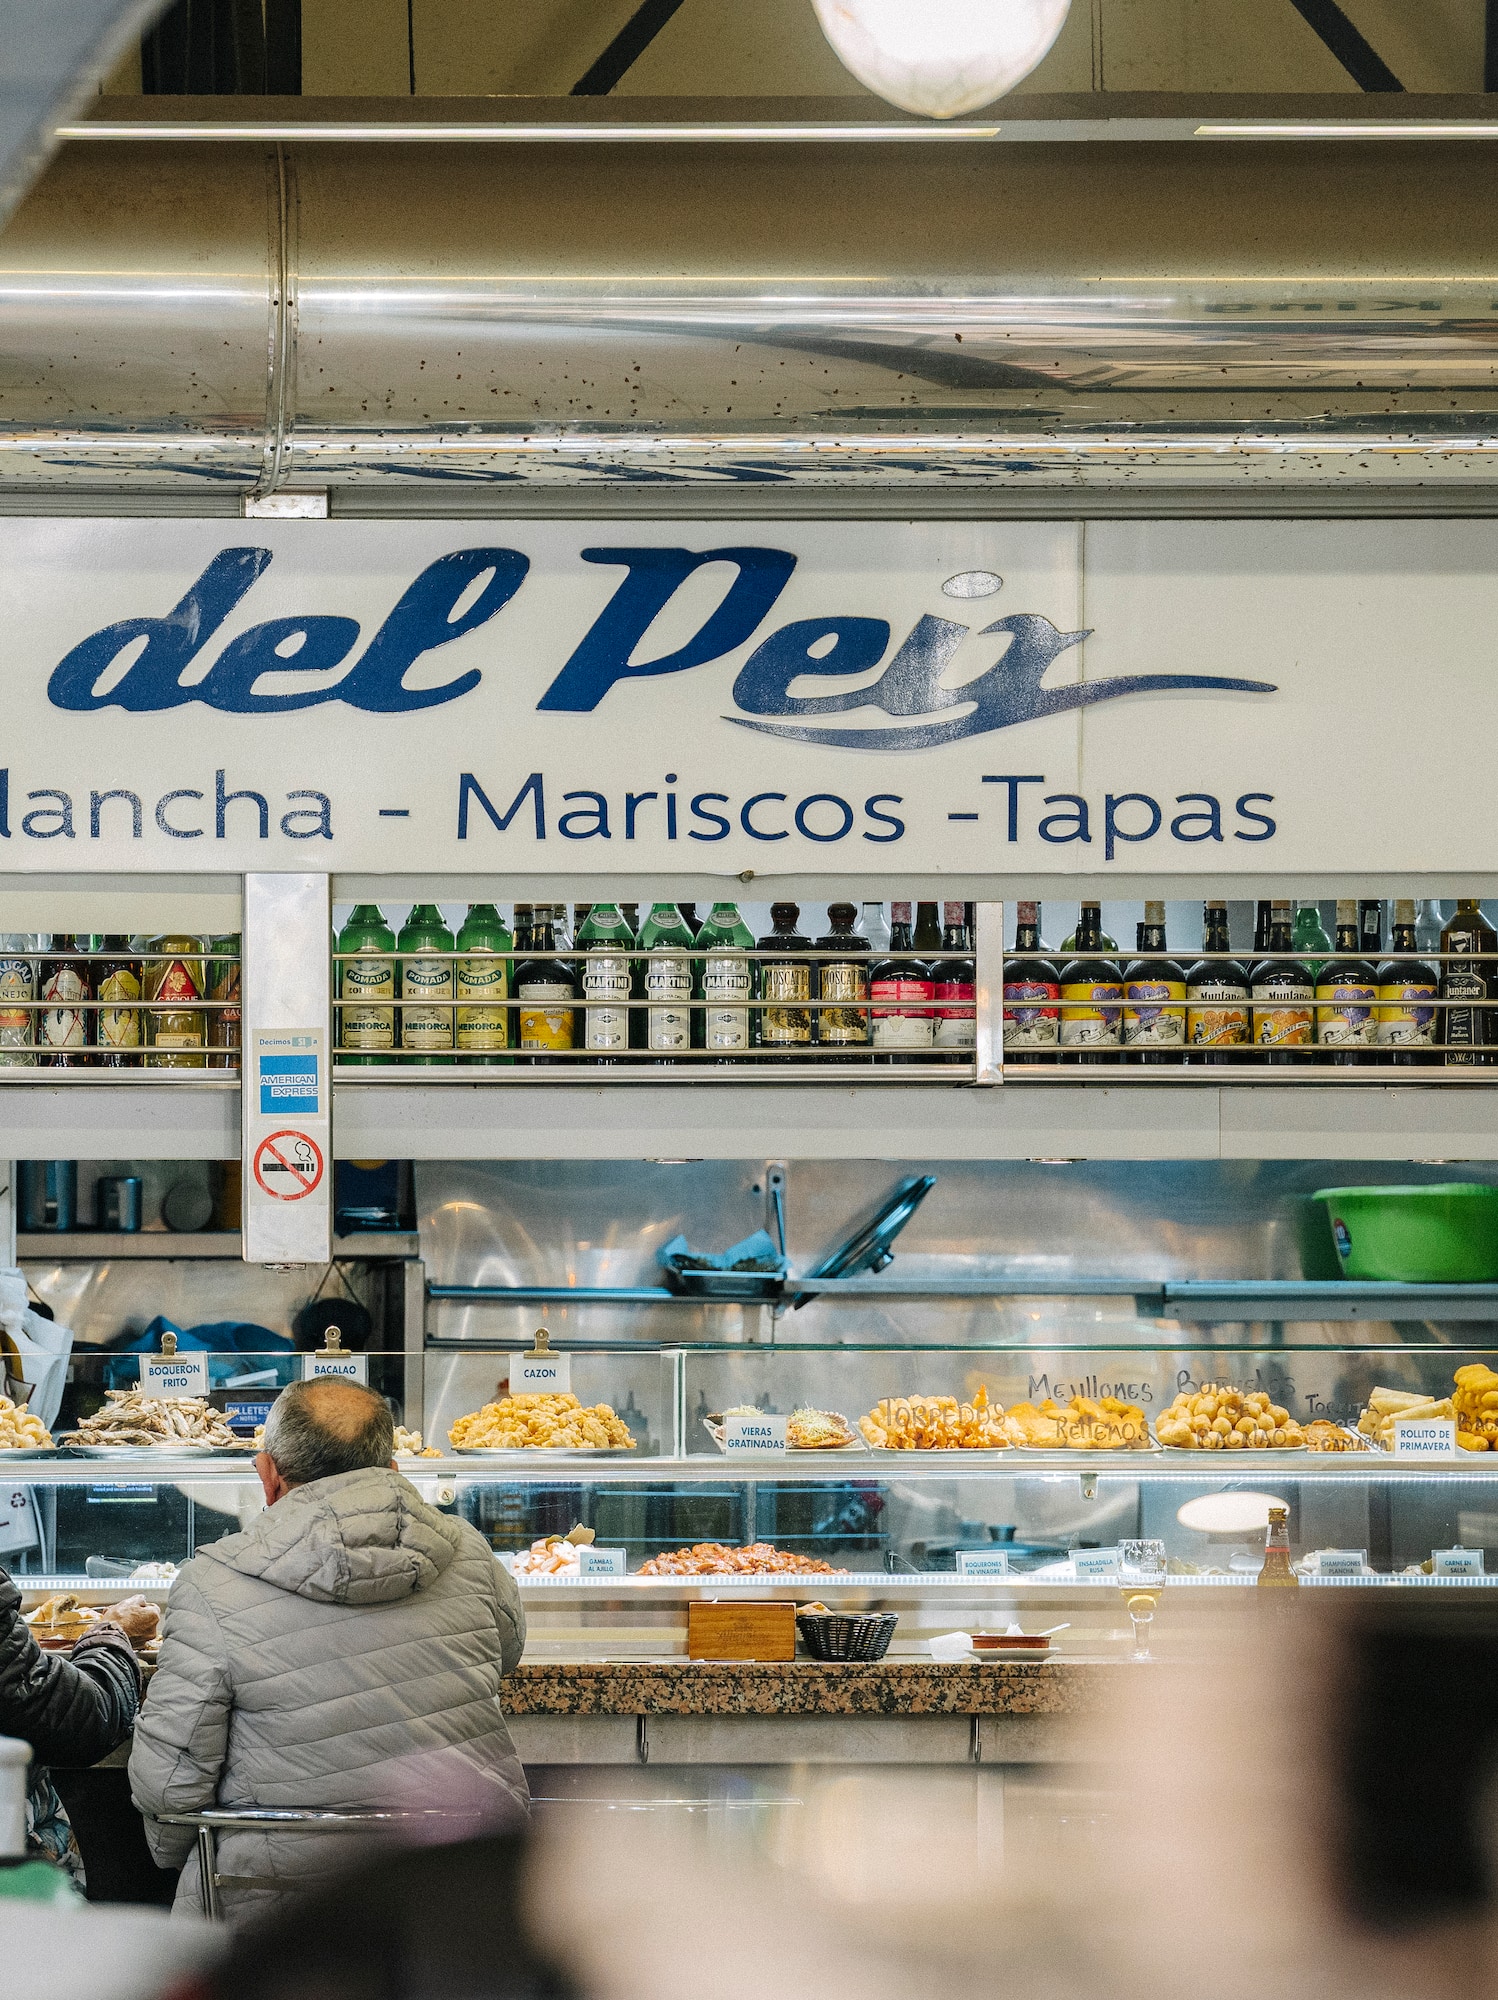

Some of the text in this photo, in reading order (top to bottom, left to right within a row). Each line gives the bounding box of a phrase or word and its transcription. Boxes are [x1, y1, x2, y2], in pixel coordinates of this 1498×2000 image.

[47, 547, 530, 713] del
[458, 773, 906, 843] Mariscos
[348, 971, 389, 984] POMADA
[408, 971, 449, 984] POMADA
[460, 971, 499, 984] POMADA
[586, 976, 628, 989] MARTINI
[649, 976, 690, 989] MARTINI
[706, 976, 748, 989] MARTINI
[405, 1023, 451, 1031] MENORCA
[261, 1076, 314, 1084] AMERICAN
[149, 1365, 200, 1376] BOQUERON
[314, 1366, 356, 1374] BACALAO
[524, 1369, 556, 1378] CAZON
[163, 1378, 187, 1387] FRITO
[741, 1427, 772, 1436] VIERAS
[1401, 1430, 1437, 1438] ROLLITO
[727, 1439, 785, 1449] GRATINADAS
[1401, 1442, 1451, 1450] PRIMAVERA
